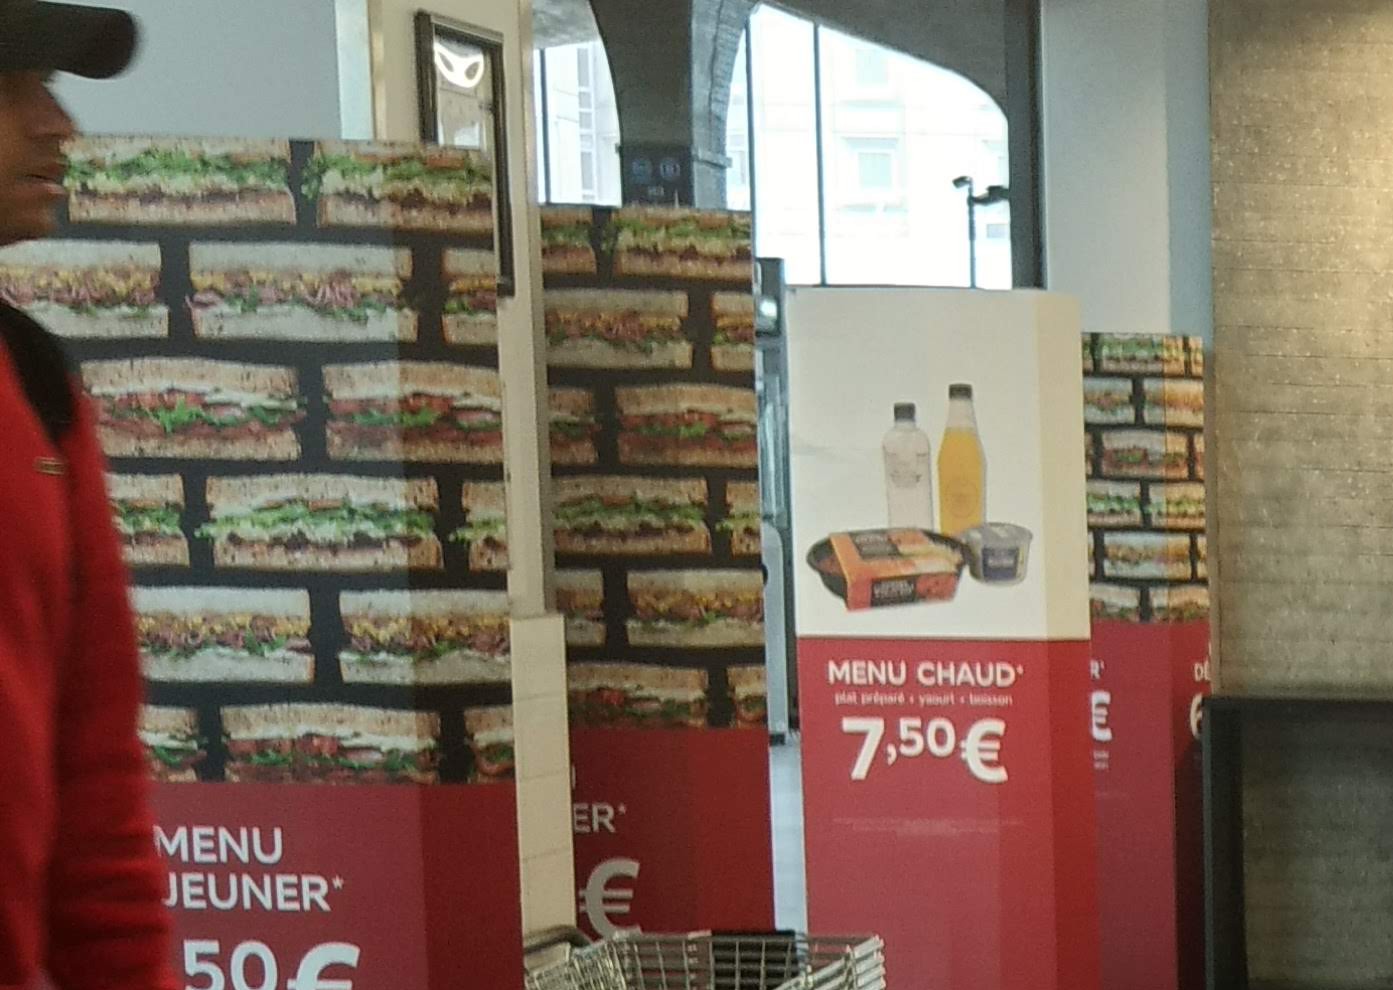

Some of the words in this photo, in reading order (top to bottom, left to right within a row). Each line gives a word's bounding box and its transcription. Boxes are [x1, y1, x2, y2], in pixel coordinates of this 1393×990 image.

[828, 659, 906, 686] MENU
[152, 825, 283, 864] MENU
[161, 872, 345, 912] JEUNER
